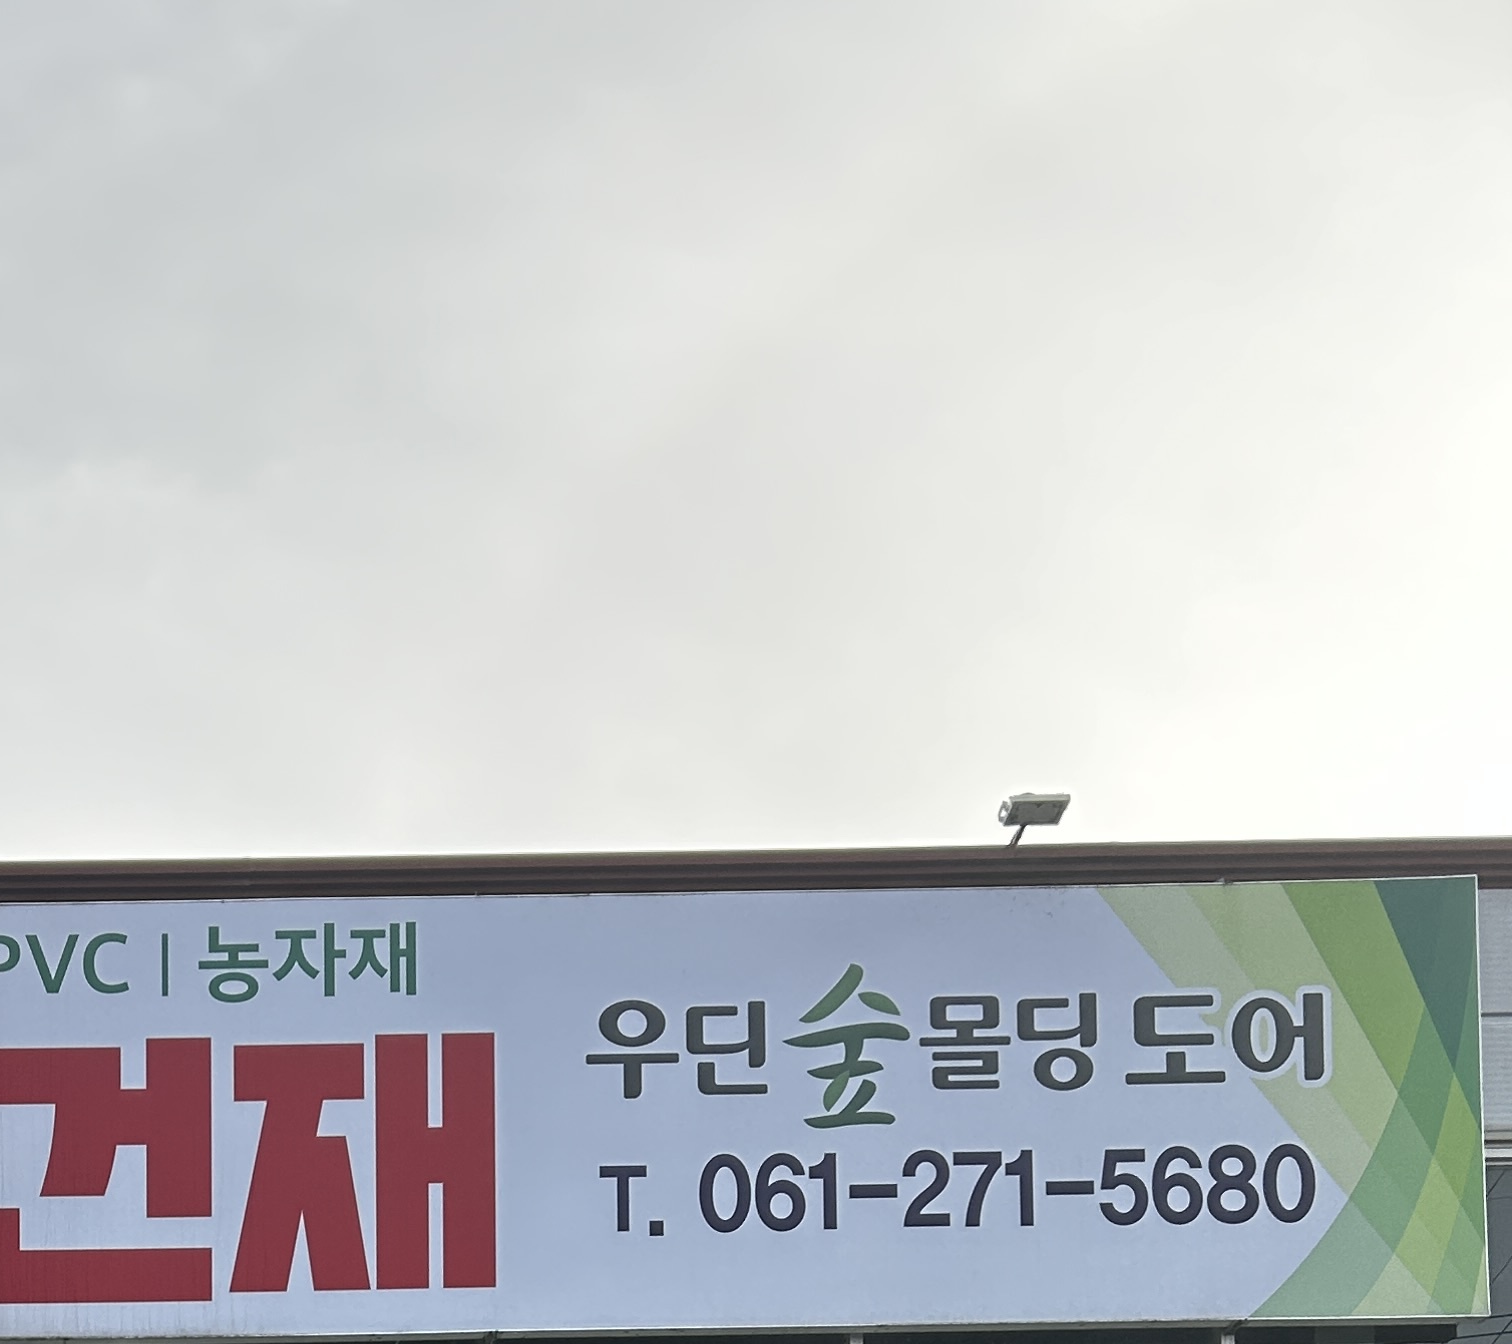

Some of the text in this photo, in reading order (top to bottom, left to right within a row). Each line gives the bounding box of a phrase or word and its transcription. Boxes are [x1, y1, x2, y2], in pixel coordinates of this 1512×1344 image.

[198, 920, 418, 1003] 농자재
[599, 1143, 1316, 1237] T. 061-271-5680
